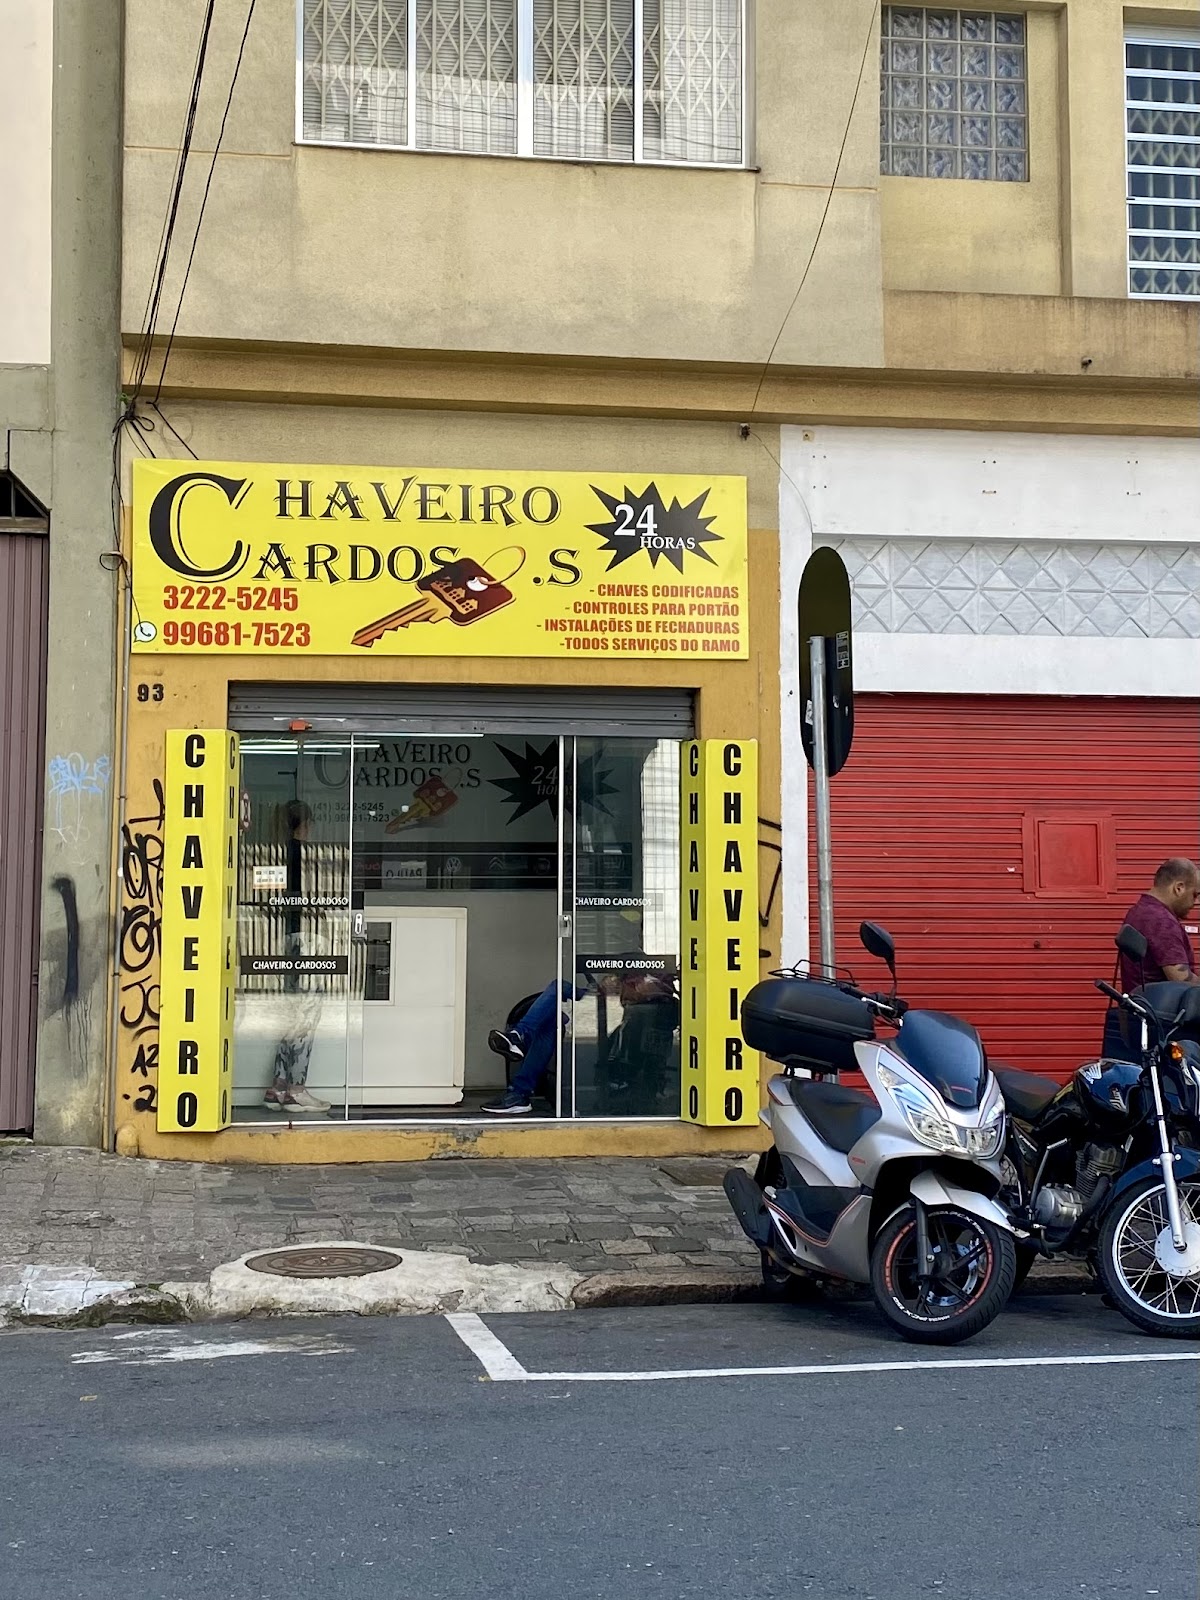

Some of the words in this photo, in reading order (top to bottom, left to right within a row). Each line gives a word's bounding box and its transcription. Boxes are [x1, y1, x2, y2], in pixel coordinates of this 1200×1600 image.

[613, 503, 658, 536] 24
[639, 536, 696, 550] HORAS
[163, 585, 299, 612] 3222-5245
[597, 583, 649, 597] CHAVES
[651, 585, 739, 599] CODIFICADAS
[573, 601, 649, 616] CONTROLES
[652, 603, 686, 616] PARA
[688, 601, 740, 617] PORTÃO
[163, 621, 311, 647] 99681-7523
[544, 617, 633, 635] INSTALAÇÕES
[636, 620, 652, 634] DE
[655, 620, 740, 635] FECHADURAS
[612, 637, 678, 653] SERVIÇOS
[681, 638, 699, 652] DO
[702, 639, 740, 652] RAMO
[137, 683, 165, 702] 93
[269, 897, 309, 906] CHAVEIRO
[311, 897, 349, 906] CARDOSO
[575, 897, 611, 906] CHAVEIRO
[612, 897, 652, 906] CARDOSOS
[176, 733, 206, 1128] CHAVEIRO
[689, 743, 700, 1120] CHAVEIRO
[723, 743, 744, 1122] CHAVEIRO
[252, 961, 293, 970] CHAVEIRO
[294, 961, 337, 970] CARDOSOS
[585, 960, 623, 969] CHAVEIRO
[625, 960, 665, 969] CARDOSOS
